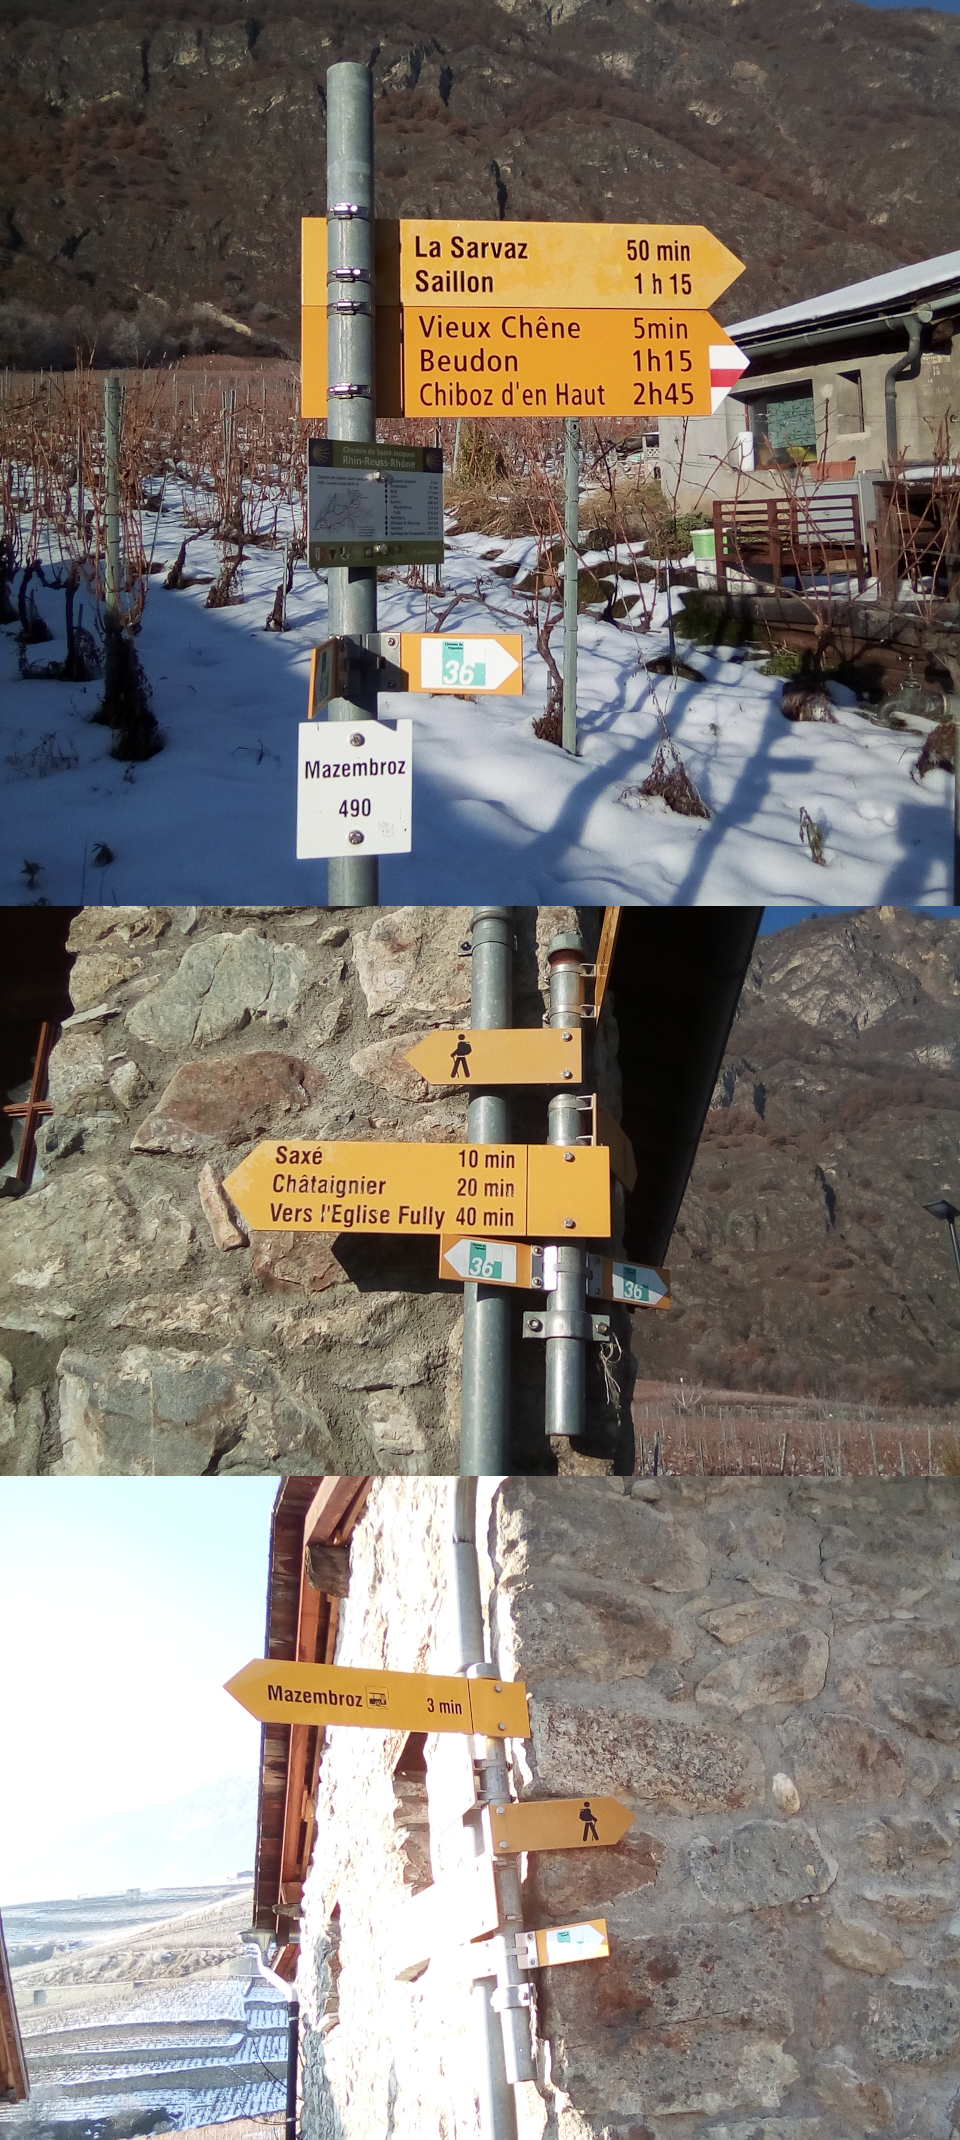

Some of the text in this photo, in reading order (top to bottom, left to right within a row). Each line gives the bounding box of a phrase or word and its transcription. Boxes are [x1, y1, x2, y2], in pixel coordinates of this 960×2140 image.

[416, 236, 527, 259] La Sarvaz
[627, 240, 690, 261] 50 min
[416, 270, 493, 292] Saillon
[634, 273, 691, 295] 1 h 15
[419, 315, 580, 338] Vieux Chêne
[634, 317, 687, 339] 5min
[421, 348, 517, 372] Beudon
[633, 349, 692, 372] 1h15
[420, 382, 605, 406] Chiboz d'en Haut
[634, 382, 693, 405] 2h45
[342, 446, 367, 454] Chemin
[376, 449, 415, 458] Saint-Jacques
[342, 456, 415, 469] Rhin-Reuss-Rhône
[443, 660, 475, 686] 36
[305, 758, 406, 779] Mazembroz
[338, 798, 371, 818] 490
[276, 1146, 322, 1164] Saxé
[459, 1150, 514, 1168] 10 min
[273, 1174, 386, 1198] Châtaignier
[457, 1178, 514, 1197] 20 min
[271, 1203, 445, 1229] Vers l'Eglise Fully
[456, 1207, 513, 1226] 40 min
[470, 1256, 494, 1278] 36
[624, 1280, 643, 1300] 36
[268, 1685, 363, 1707] Mazembroz
[427, 1698, 462, 1714] 3 min
